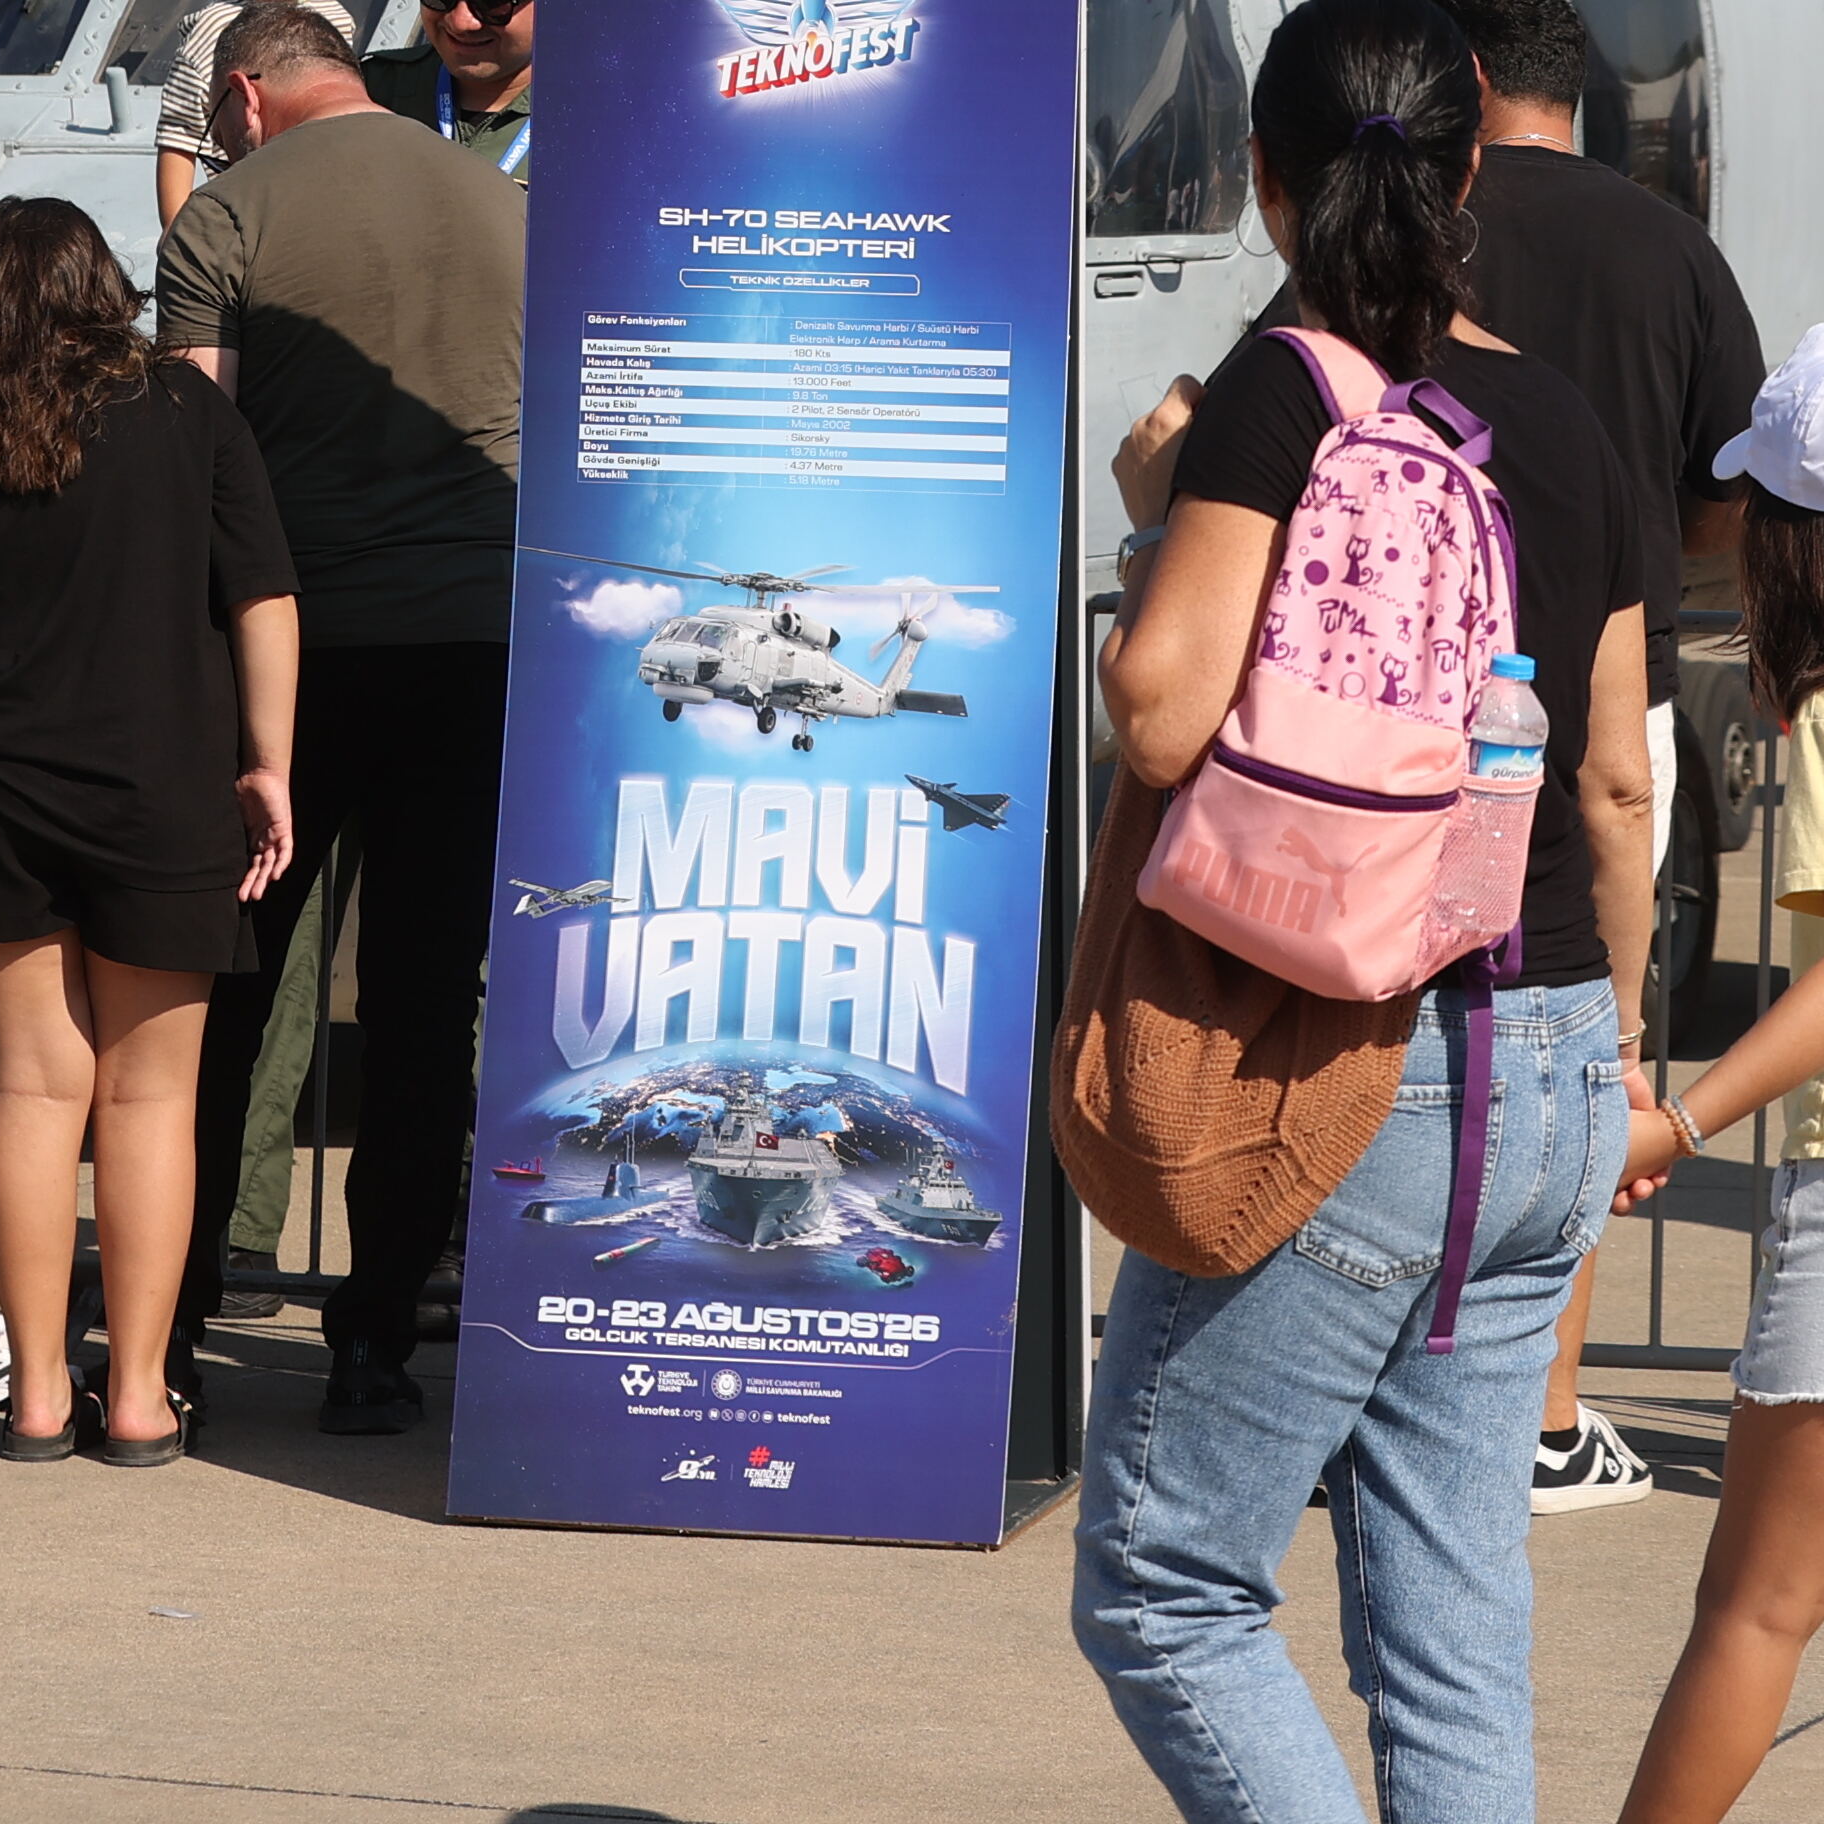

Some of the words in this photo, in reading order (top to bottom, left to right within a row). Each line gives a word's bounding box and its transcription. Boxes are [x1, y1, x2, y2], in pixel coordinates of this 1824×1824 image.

[717, 17, 920, 98] TEKNOFEST
[659, 207, 768, 228] SH-70
[774, 210, 952, 233] SEAHAWK
[692, 233, 915, 260] HELİKOPTERİ
[730, 274, 780, 285] TEKNİK
[587, 314, 618, 325] Görev
[620, 315, 687, 327] Fonksiyonları
[837, 322, 881, 332] Savunma
[883, 323, 909, 333] Harbi
[953, 325, 980, 335] Harbi
[789, 334, 836, 344] Elektronik
[837, 336, 861, 346] Harp
[869, 337, 900, 346] Arama
[903, 338, 947, 347] Kurtarma
[587, 343, 641, 353] Maksimum
[794, 349, 812, 358] 180
[815, 350, 831, 358] Kts
[586, 357, 624, 368] Havada
[793, 363, 822, 373] Azami
[887, 365, 910, 375] Yakıt
[586, 372, 617, 381] Azami
[619, 371, 644, 381] İrtifa
[793, 378, 828, 386] 13.000
[830, 379, 852, 387] Feet
[811, 392, 829, 401] Ton
[585, 400, 610, 410] Uçuş
[613, 400, 638, 409] Ekibi
[791, 405, 800, 414] 2
[827, 406, 835, 415] 2
[584, 413, 625, 424] Hizmete
[654, 415, 682, 425] Tarihi
[822, 420, 852, 430] 2002
[584, 426, 618, 436] Üretici
[620, 429, 649, 438] Firma
[791, 433, 831, 444] Sikorsky
[583, 442, 609, 453] Boyu
[819, 449, 849, 458] Metre
[583, 455, 615, 465] Gövde
[617, 455, 661, 467] Genişliği
[814, 462, 844, 471] Metre
[582, 469, 630, 480] Yükseklik
[810, 476, 841, 486] Metre
[1414, 500, 1463, 555] PUMA
[1317, 598, 1378, 638] PUMA
[1431, 639, 1467, 674] PUM
[1174, 836, 1323, 934] PUMA
[551, 911, 975, 1098] VATAN
[537, 1295, 667, 1328] 20-23
[626, 1403, 703, 1422] teknofest.org
[777, 1412, 831, 1425] teknofest
